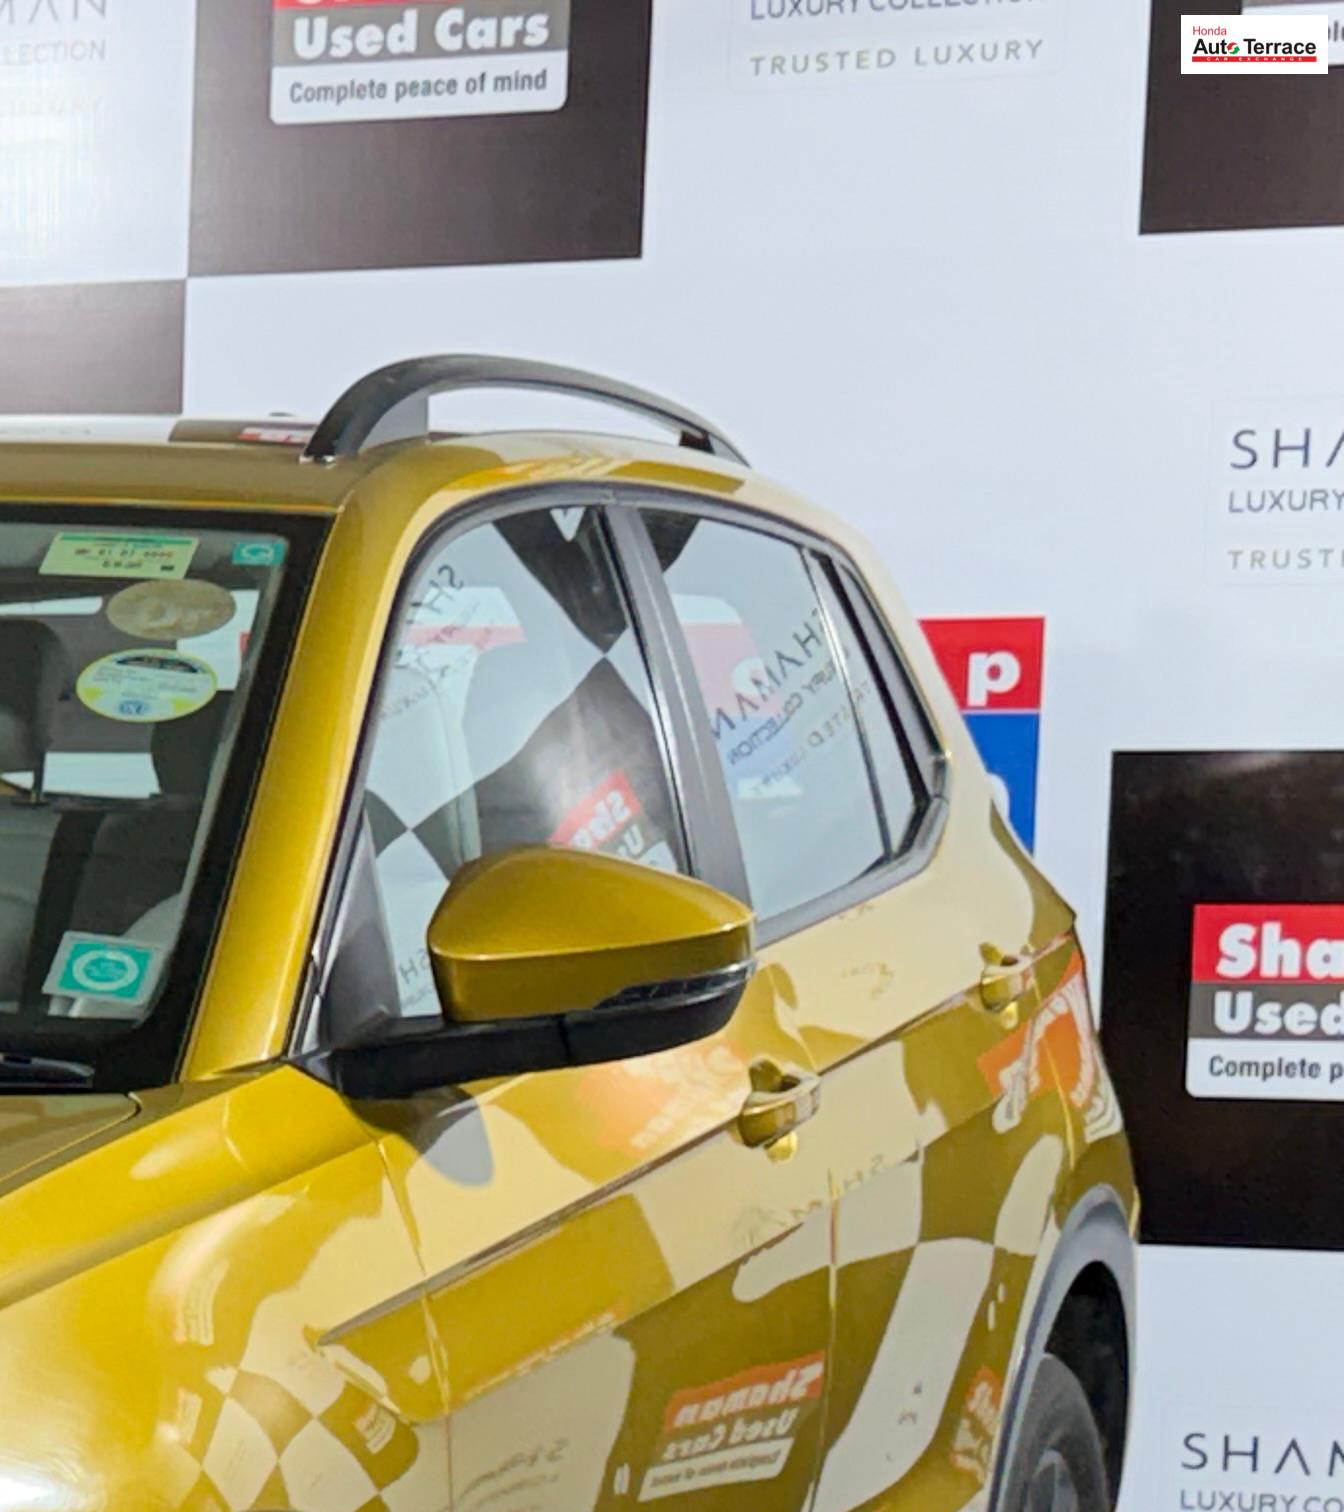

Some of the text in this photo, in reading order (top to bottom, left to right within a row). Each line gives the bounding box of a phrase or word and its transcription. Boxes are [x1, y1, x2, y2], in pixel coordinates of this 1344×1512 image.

[294, 8, 549, 60] Used Cars
[750, 38, 1044, 76] TRUSTED LUXURY
[289, 69, 548, 105] Complete peace of mind
[1227, 548, 1344, 569] TRUST
[1208, 1055, 1321, 1082] Complete
